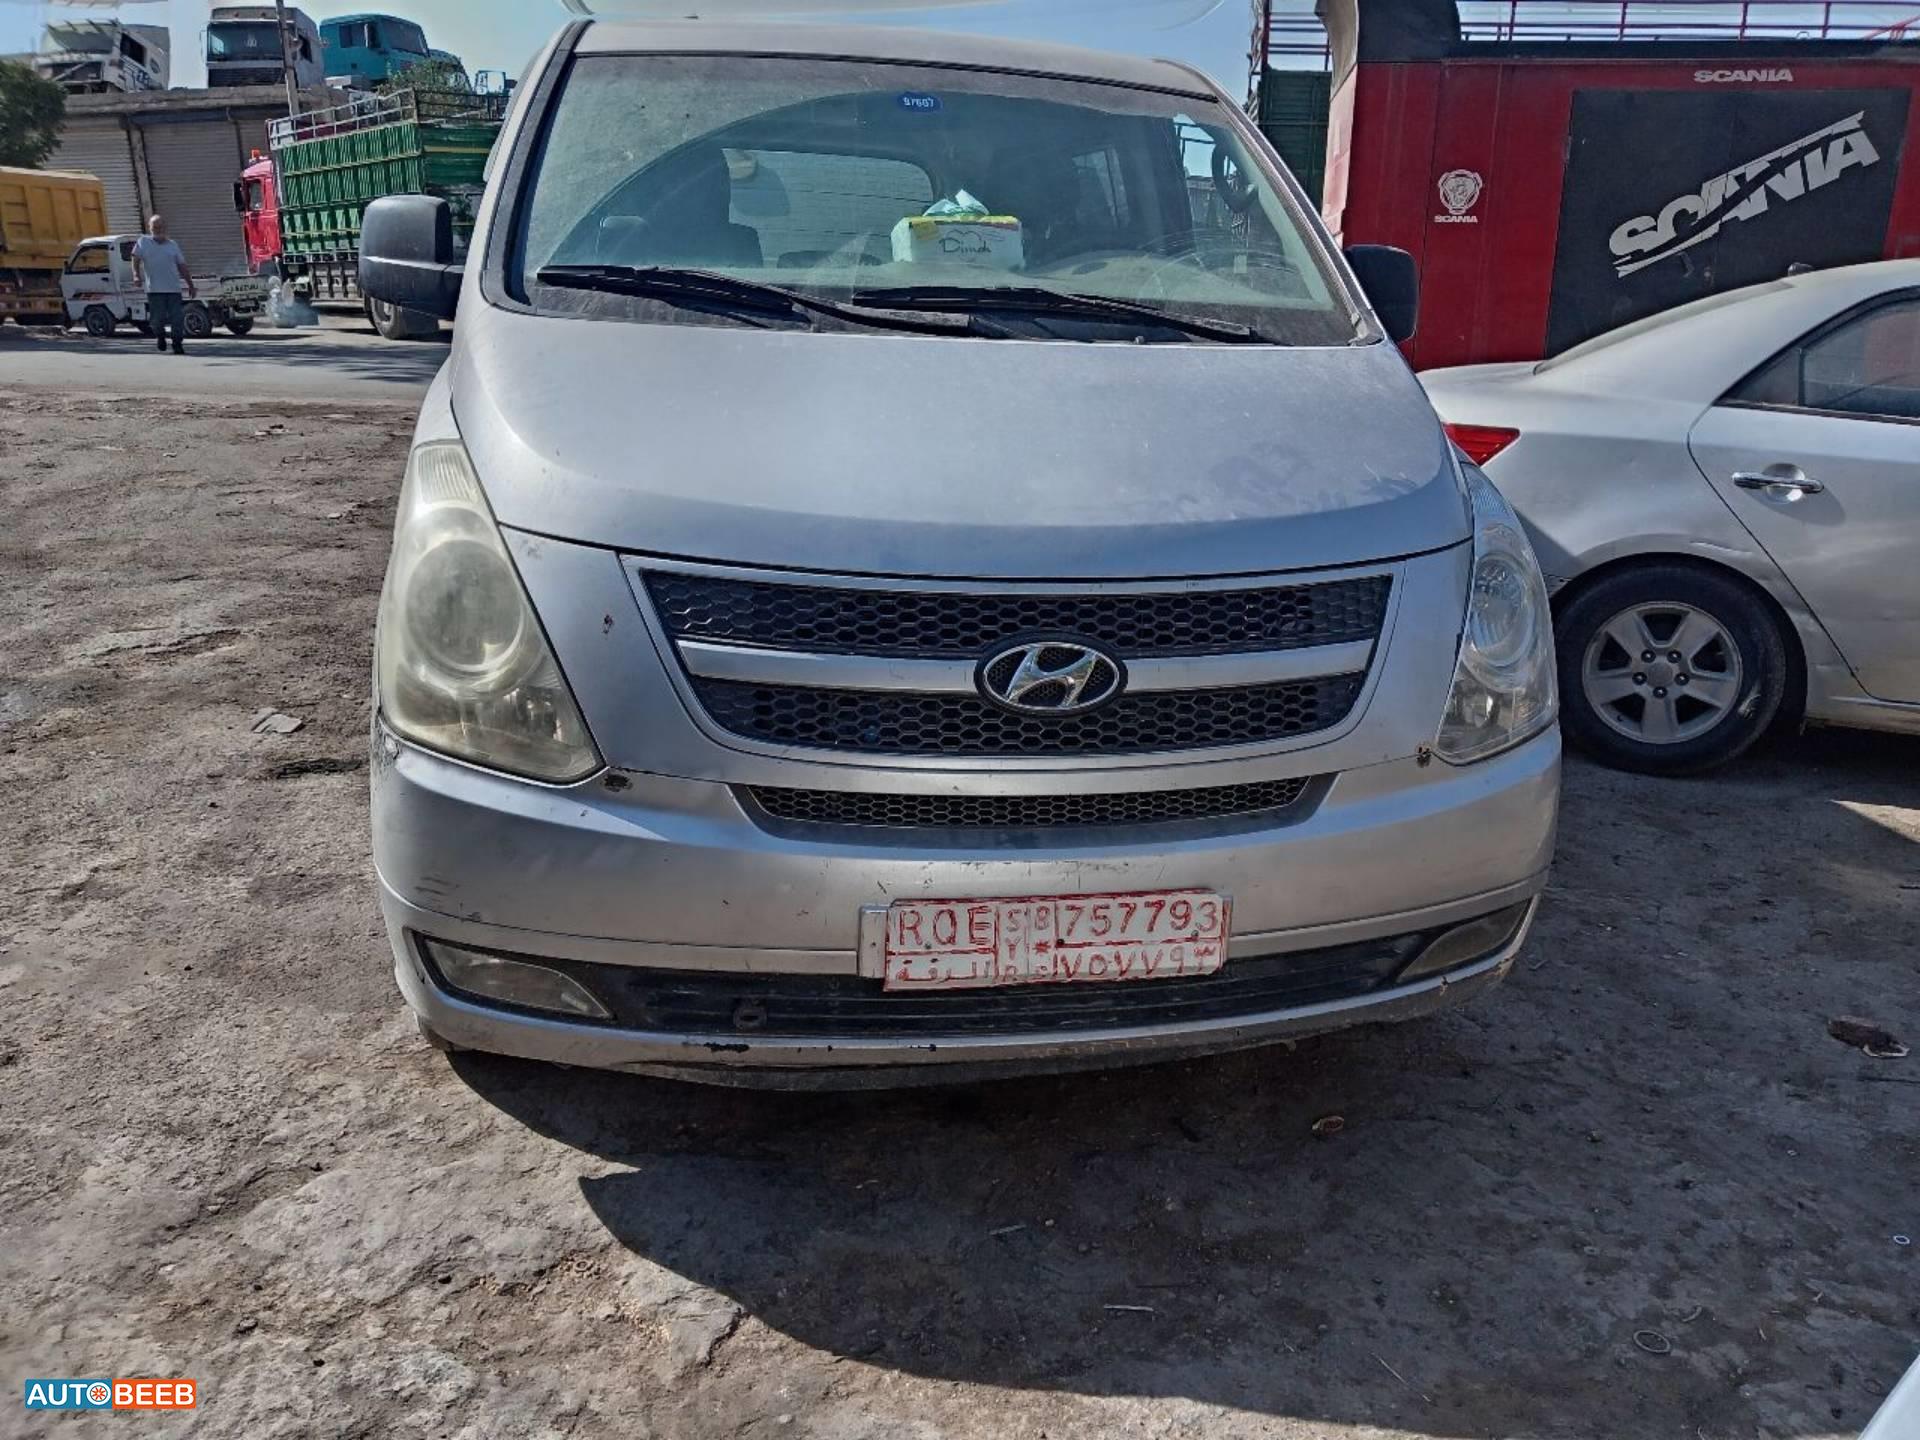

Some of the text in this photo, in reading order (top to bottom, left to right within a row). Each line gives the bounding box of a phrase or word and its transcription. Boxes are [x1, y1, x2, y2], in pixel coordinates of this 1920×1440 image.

[1694, 68, 1793, 82] SCANIA
[1609, 110, 1880, 279] SCANIA
[1434, 215, 1479, 223] SCANIA
[899, 898, 1219, 947] RQE 757793
